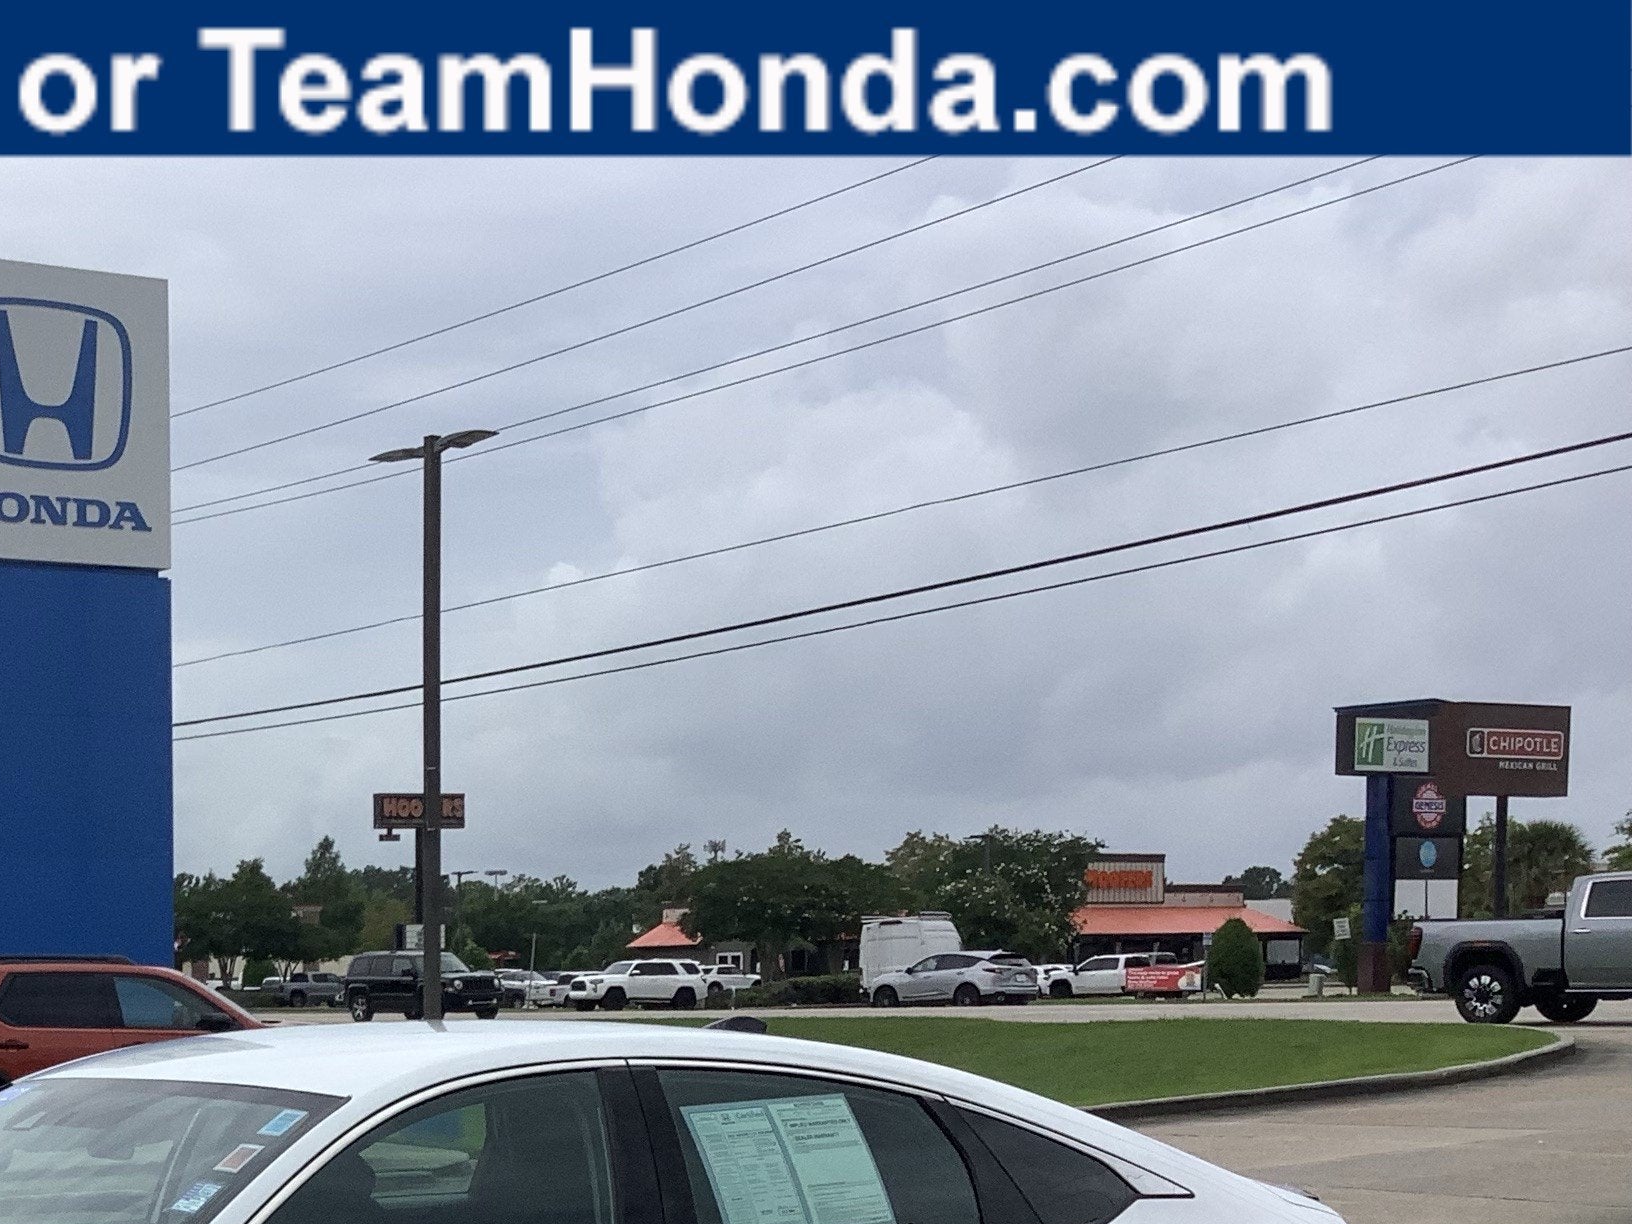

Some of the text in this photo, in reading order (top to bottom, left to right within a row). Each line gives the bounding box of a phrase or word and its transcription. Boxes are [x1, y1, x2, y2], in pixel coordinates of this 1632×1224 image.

[1386, 736, 1426, 754] Express
[1489, 735, 1560, 753] CHIPOTLE
[1499, 761, 1558, 771] MEXICAN GRILL
[382, 797, 463, 818] HOORS
